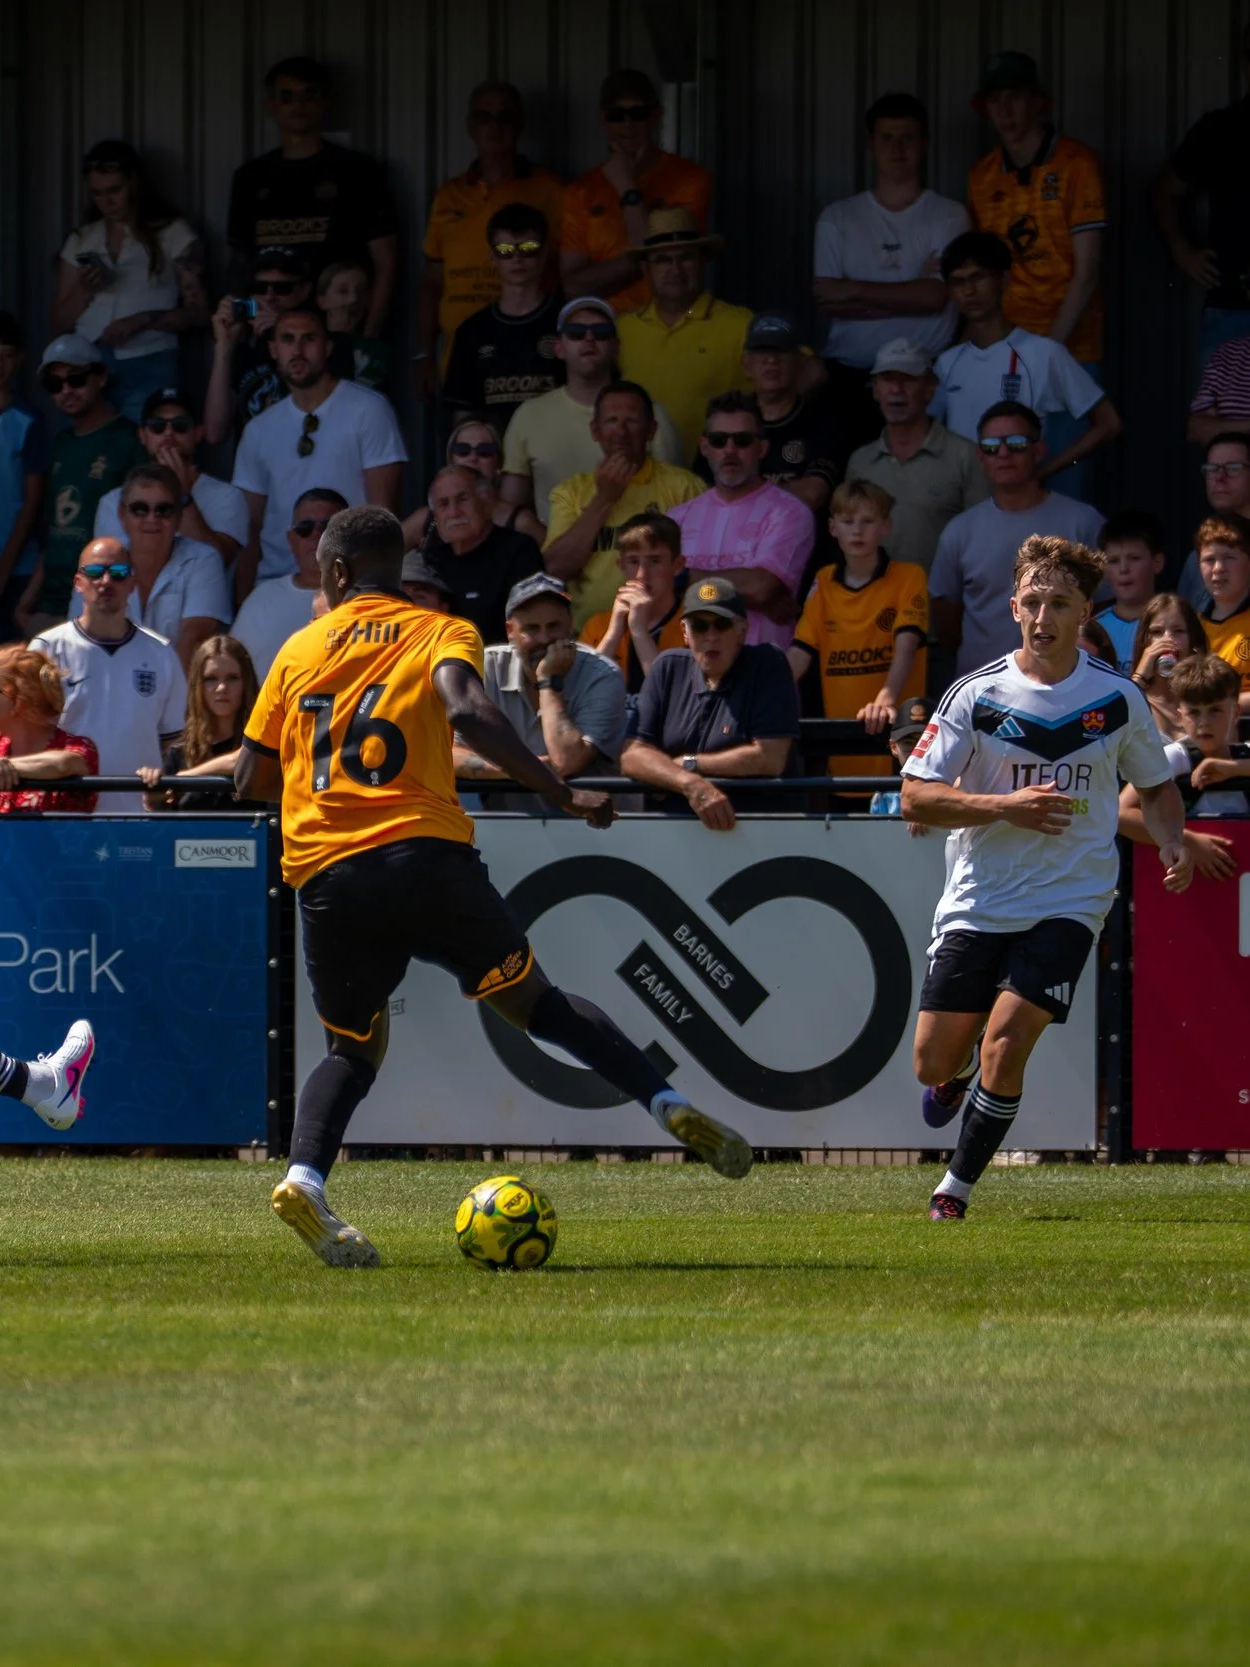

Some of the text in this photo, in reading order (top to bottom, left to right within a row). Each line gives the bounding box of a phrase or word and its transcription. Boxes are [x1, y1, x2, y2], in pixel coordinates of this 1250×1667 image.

[255, 216, 330, 236] BROOKS
[352, 621, 401, 645] Hill
[299, 684, 407, 793] 16
[178, 845, 251, 862] CANMOOR
[673, 924, 735, 990] BARNES
[633, 963, 692, 1024] FAMILY
